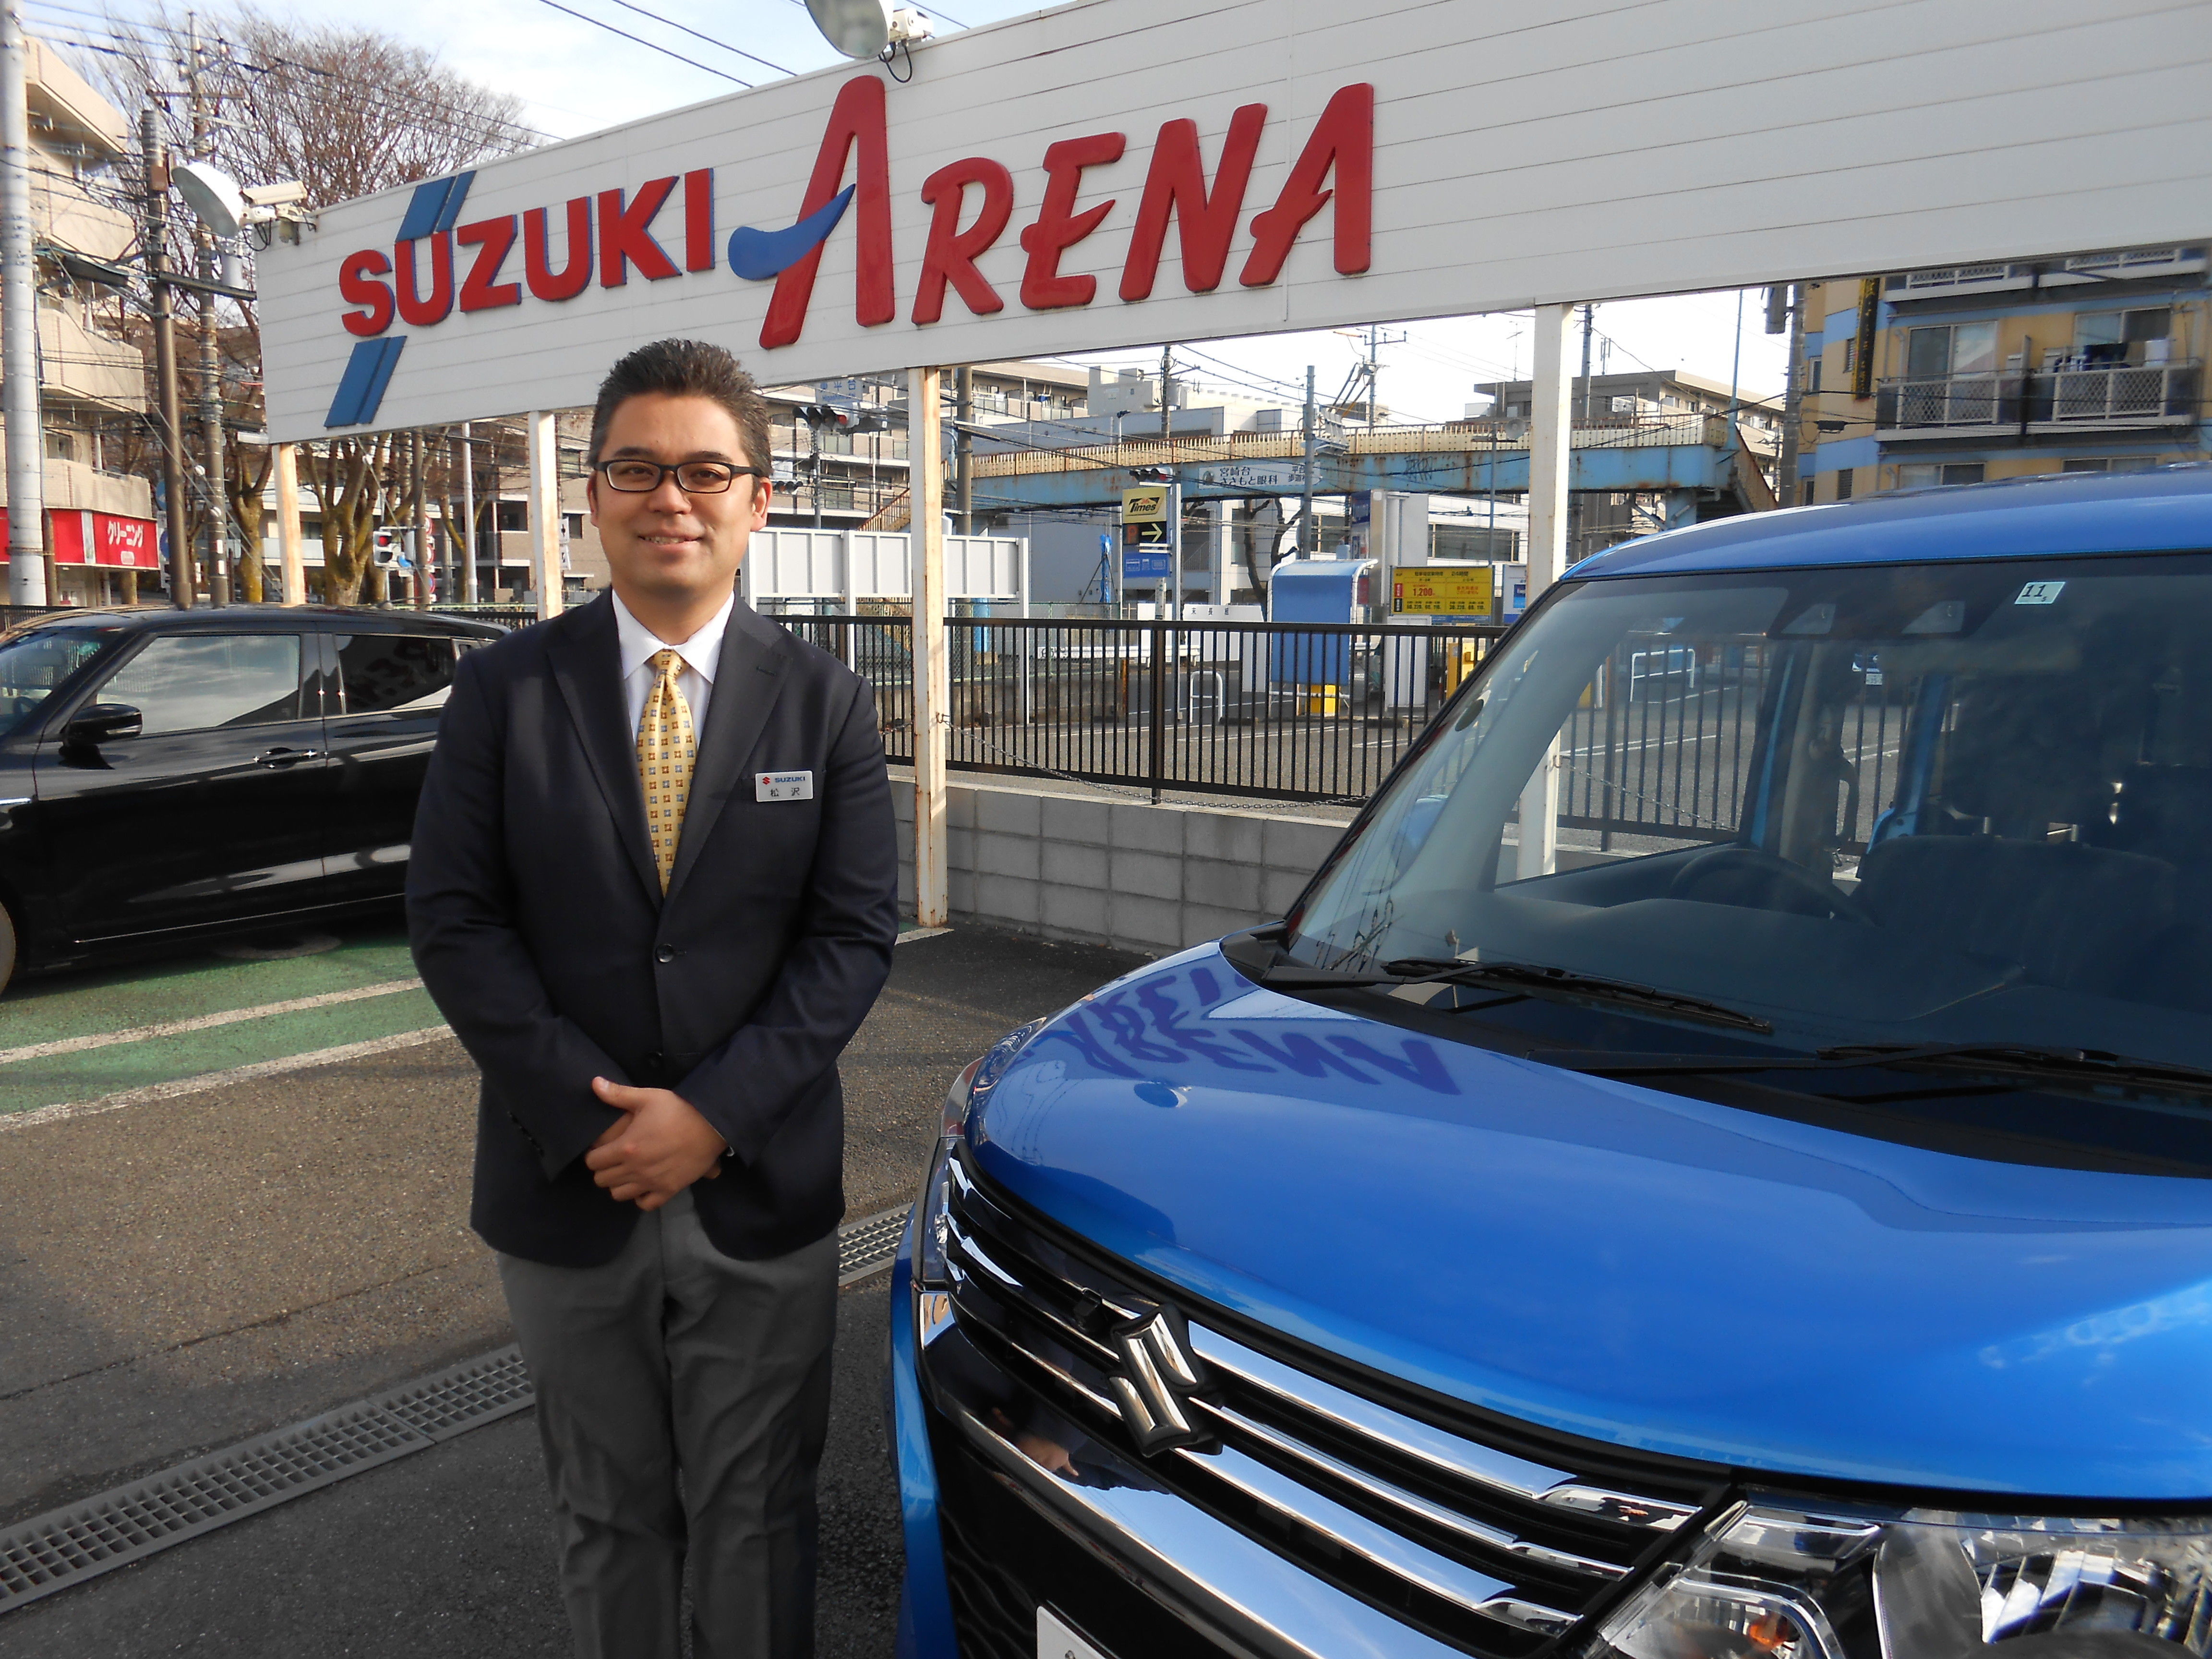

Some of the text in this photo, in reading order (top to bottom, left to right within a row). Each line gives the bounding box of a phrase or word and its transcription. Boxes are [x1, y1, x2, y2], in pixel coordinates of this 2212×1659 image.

[339, 75, 1374, 350] SUZUKI ARENA
[1220, 466, 1250, 477] 宮崎台
[1220, 474, 1277, 486] ささもと眼科
[1288, 474, 1305, 482] 歩道
[1129, 497, 1160, 513] Times
[107, 520, 144, 548] クリーニング
[2021, 585, 2046, 597] 11
